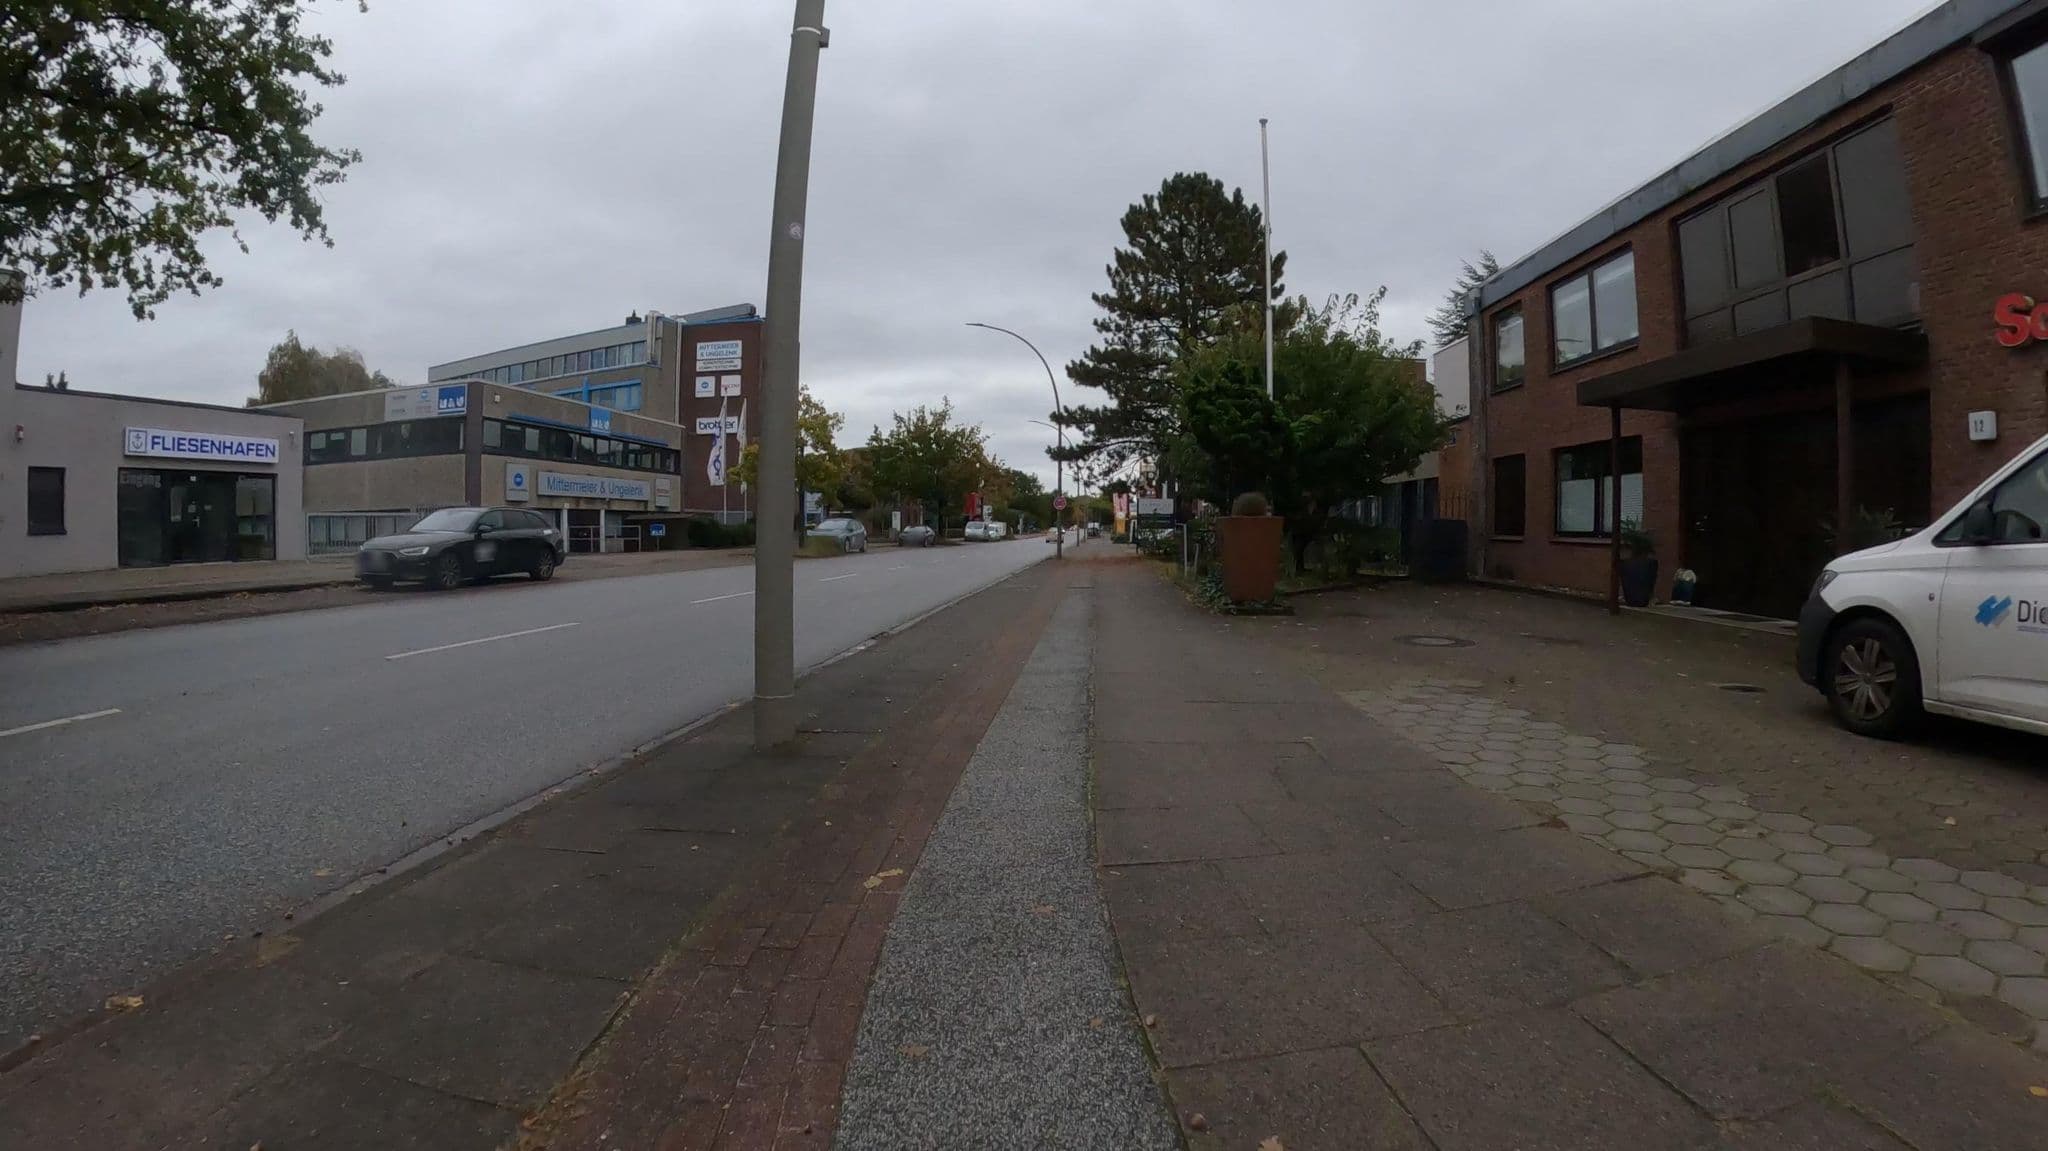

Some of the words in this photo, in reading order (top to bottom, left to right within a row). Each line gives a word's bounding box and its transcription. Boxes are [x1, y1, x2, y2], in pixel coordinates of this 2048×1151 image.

[151, 435, 276, 458] FLIESENHAFEN
[547, 476, 597, 493] Mittermeier
[599, 482, 606, 494] &
[609, 482, 644, 497] Ungelenk
